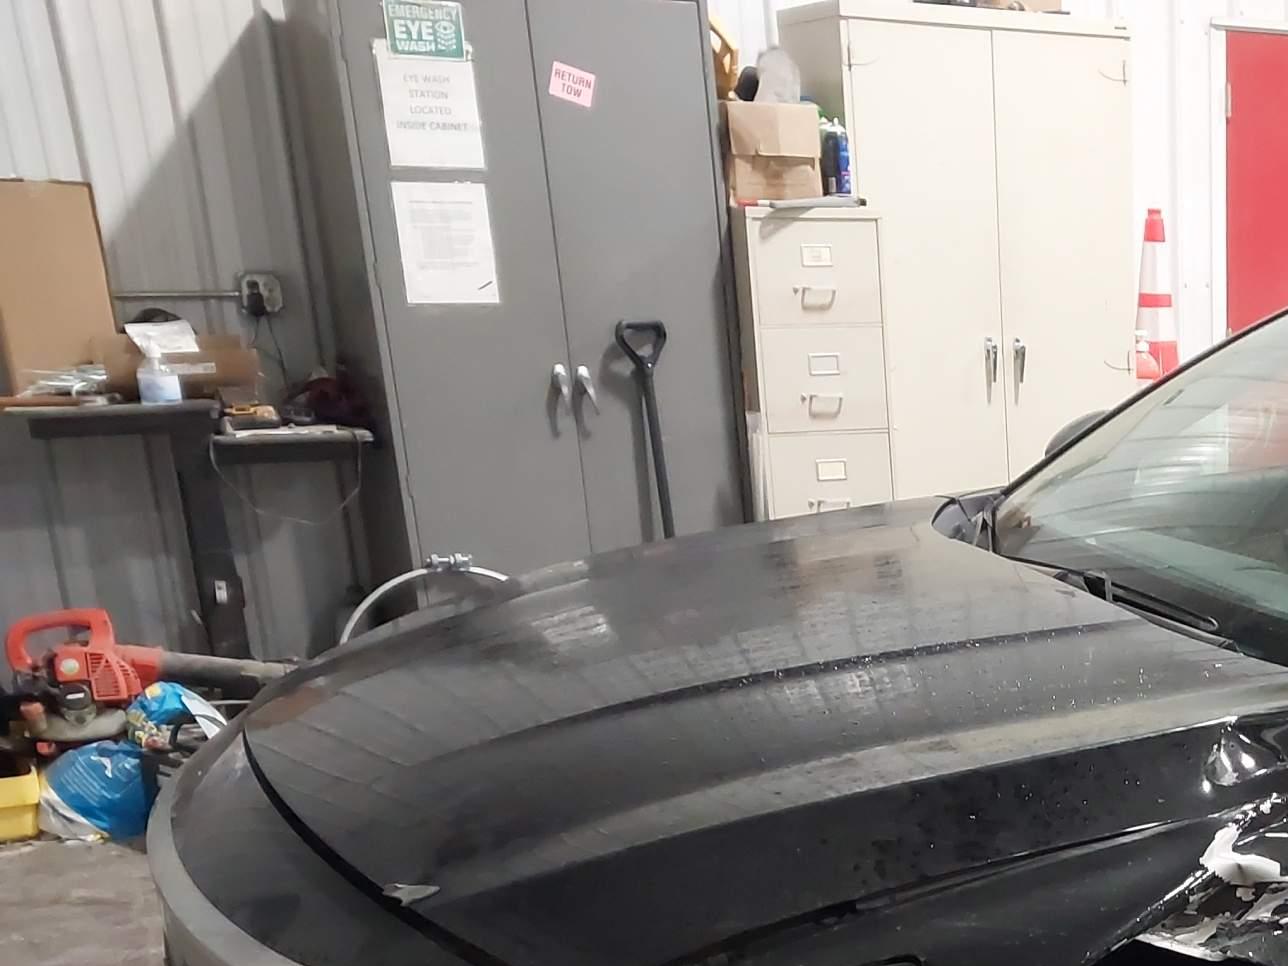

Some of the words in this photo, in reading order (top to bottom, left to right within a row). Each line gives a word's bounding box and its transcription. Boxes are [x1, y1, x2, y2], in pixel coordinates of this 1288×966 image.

[387, 4, 457, 20] EMERGENCY
[393, 19, 434, 40] EYE
[395, 40, 436, 52] WASH
[403, 74, 419, 83] EYE
[423, 75, 451, 83] WASH
[554, 69, 592, 89] RETURN
[408, 89, 449, 99] STATION
[562, 83, 582, 98] TOW
[409, 105, 452, 115] LOCATED
[396, 121, 427, 130] INSIDE
[430, 122, 468, 131] CABINET
